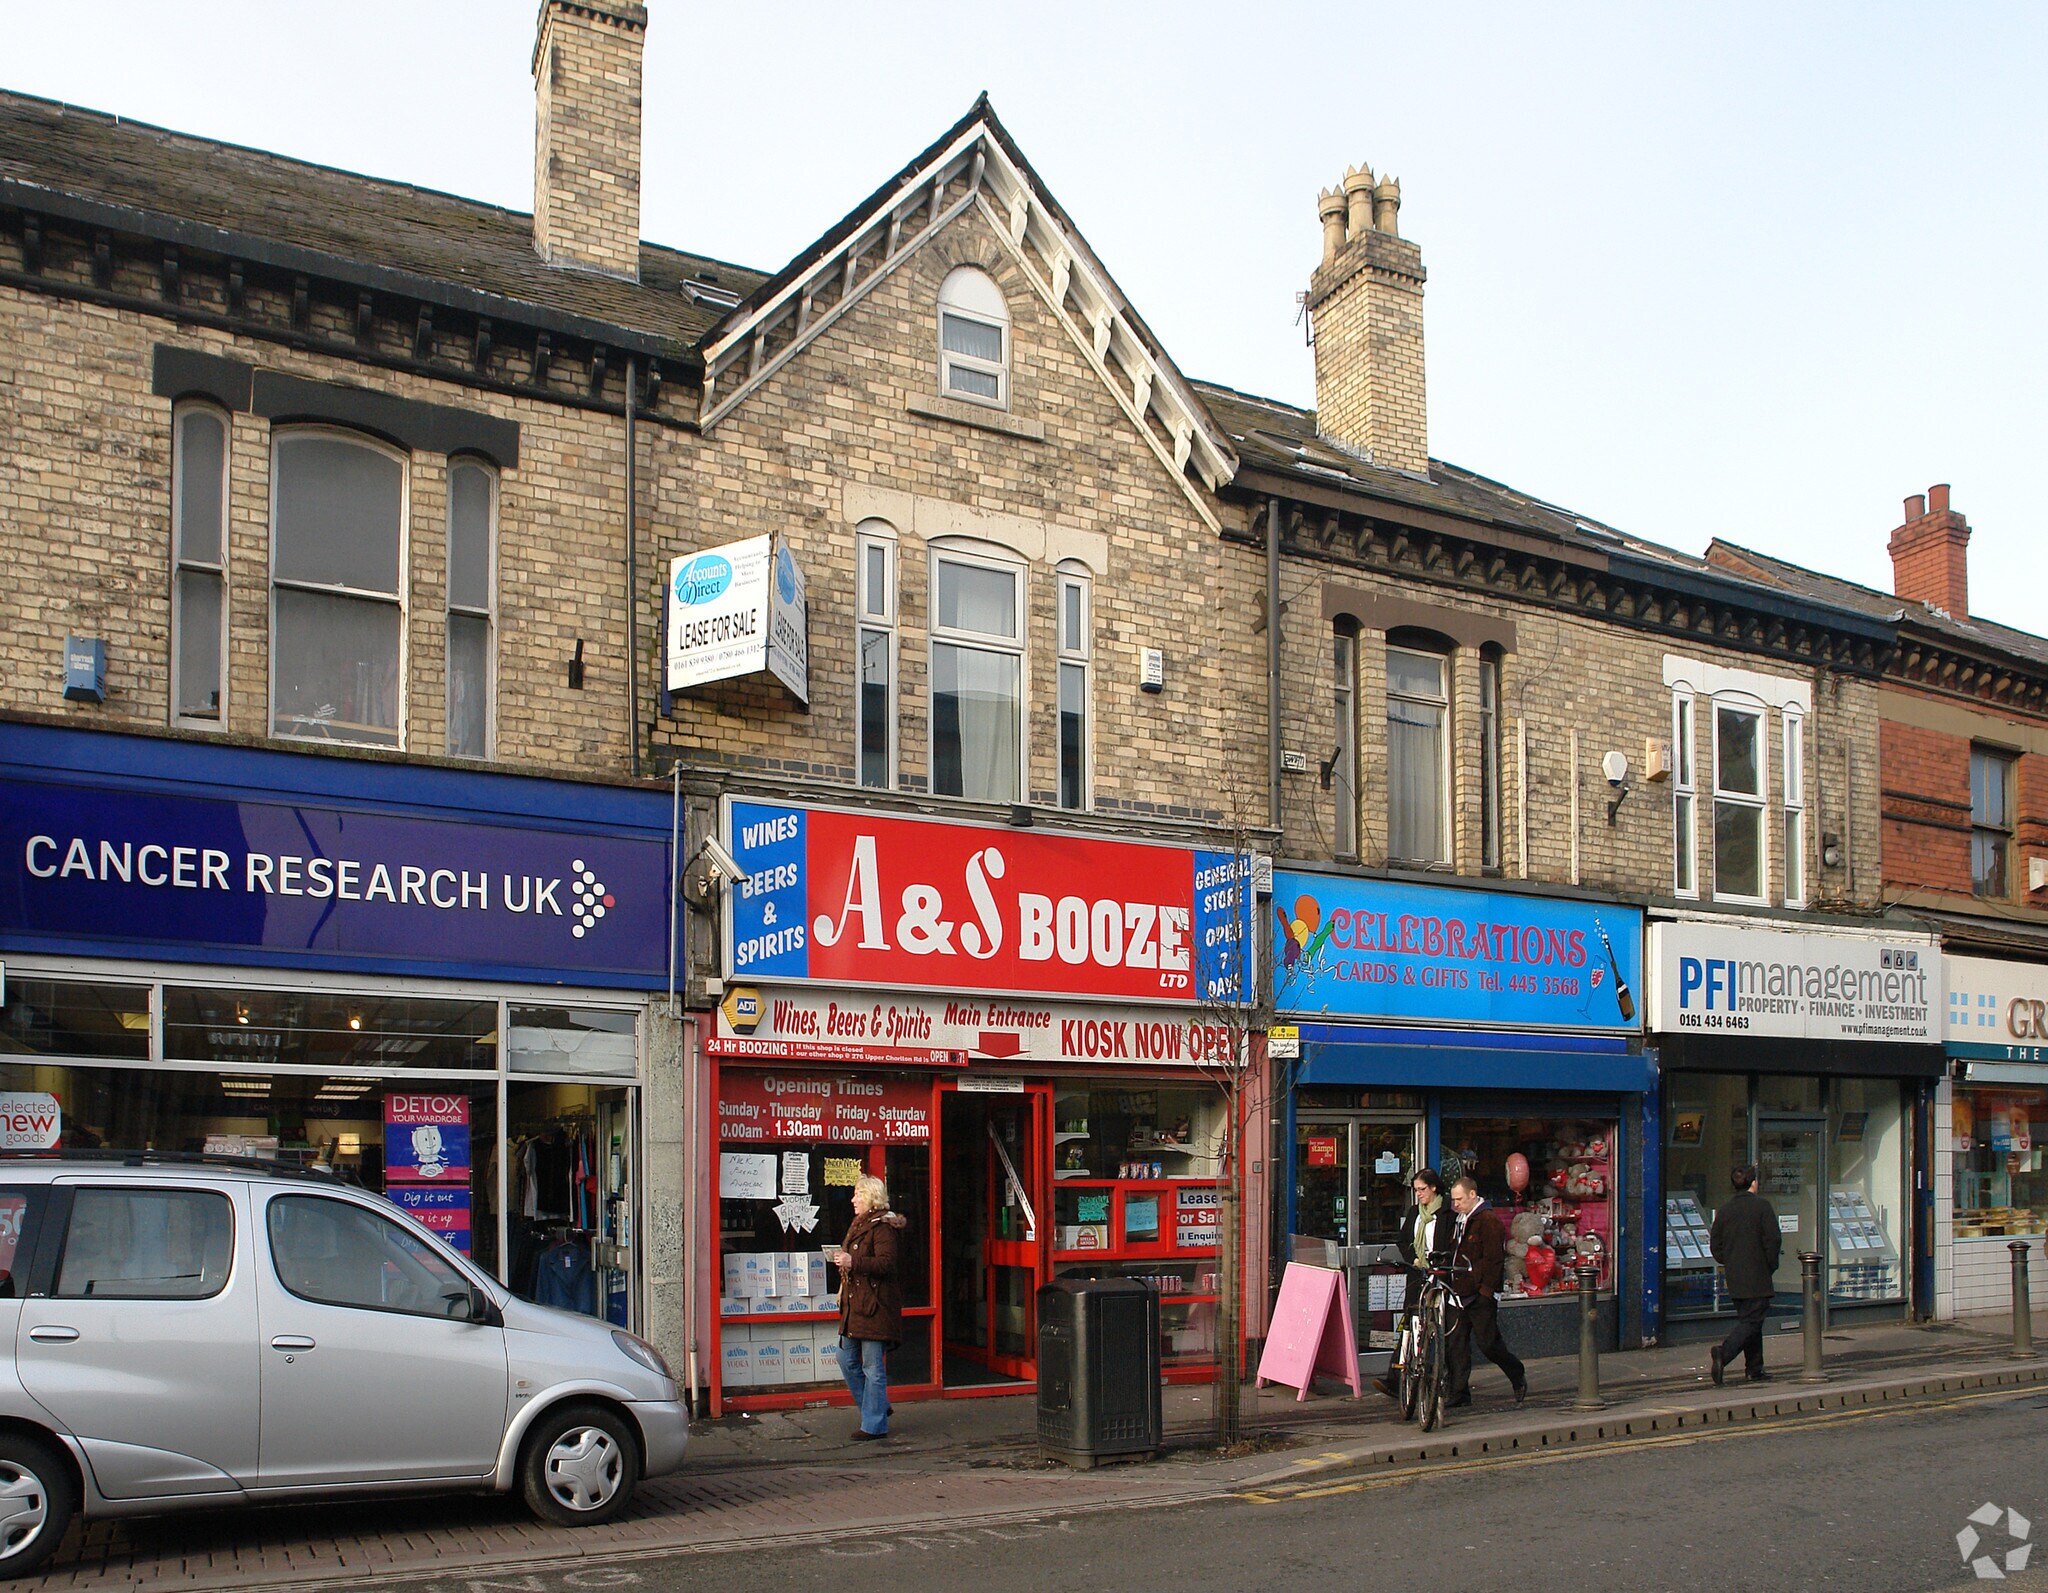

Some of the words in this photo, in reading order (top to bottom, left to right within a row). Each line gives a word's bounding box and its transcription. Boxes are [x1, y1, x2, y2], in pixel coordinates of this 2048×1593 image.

[675, 558, 727, 591] Accounts
[678, 580, 721, 610] Direct
[680, 619, 709, 651] LEASE
[711, 615, 731, 644] FOR
[733, 608, 757, 638] SALE
[742, 814, 798, 850] WINES
[26, 835, 230, 890] CANCER
[246, 852, 488, 910] RESEARCH
[503, 874, 563, 916] UK
[741, 862, 798, 900] BEERS
[1195, 859, 1250, 891] GENERAL
[763, 901, 778, 926] &
[1018, 892, 1191, 971] BOOZE
[1329, 907, 1587, 968] CELEBRATIONS
[736, 925, 805, 967] SPIRITS
[1159, 973, 1189, 989] LTD
[1336, 960, 1398, 984] CARDS
[1403, 965, 1416, 986] &
[1421, 967, 1469, 989] GIFTS
[1477, 970, 1504, 992] Tel.
[1508, 974, 1537, 994] 445
[1542, 976, 1579, 996] 3568
[737, 1000, 757, 1012] ADT
[943, 1002, 982, 1027] Main
[986, 1003, 1051, 1029] Entrance
[1738, 996, 1798, 1015] PROPERTY
[1809, 1001, 1855, 1018] FINANCE
[1865, 1004, 1928, 1022] INVESTMENT
[773, 999, 821, 1041] Wines,
[826, 1001, 867, 1038] Beers
[870, 1004, 882, 1037] &
[886, 1006, 932, 1047] Spirits
[1679, 1014, 1702, 1027] 0161
[1704, 1015, 1723, 1028] 434
[1726, 1016, 1750, 1029] 6463
[1840, 1022, 1928, 1038] www.pfimanagement.co.uk
[708, 1039, 721, 1053] 24
[723, 1040, 737, 1054] Hr
[739, 1040, 788, 1056] BOOZING
[802, 1043, 815, 1051] this
[816, 1045, 833, 1053] shop
[1061, 1019, 1128, 1059] KIOSK
[1134, 1022, 1183, 1060] NOW
[827, 1052, 844, 1060] shop
[864, 1053, 885, 1063] Upper
[929, 1051, 949, 1063] OPEN
[2006, 1046, 2040, 1060] THE
[763, 1077, 831, 1097] Opening
[835, 1080, 884, 1096] Times
[393, 1095, 462, 1114] DETOX
[719, 1101, 760, 1120] Sunday
[769, 1102, 822, 1121] Thursday
[835, 1105, 870, 1123] Friday
[392, 1114, 415, 1123] YOUR
[416, 1114, 462, 1123] WARDROBE
[774, 1119, 823, 1137] 1.30am
[884, 1121, 929, 1138] 1.30am
[6, 1131, 46, 1146] goods
[1312, 1145, 1333, 1153] stamps
[403, 1191, 421, 1207] Dig
[424, 1192, 434, 1202] it
[437, 1192, 453, 1203] out
[1180, 1192, 1217, 1205] Lease
[410, 1212, 424, 1224] ag
[427, 1213, 438, 1223] it
[440, 1214, 453, 1227] up
[443, 1232, 456, 1244] ff
[727, 1361, 749, 1369] VODKA
